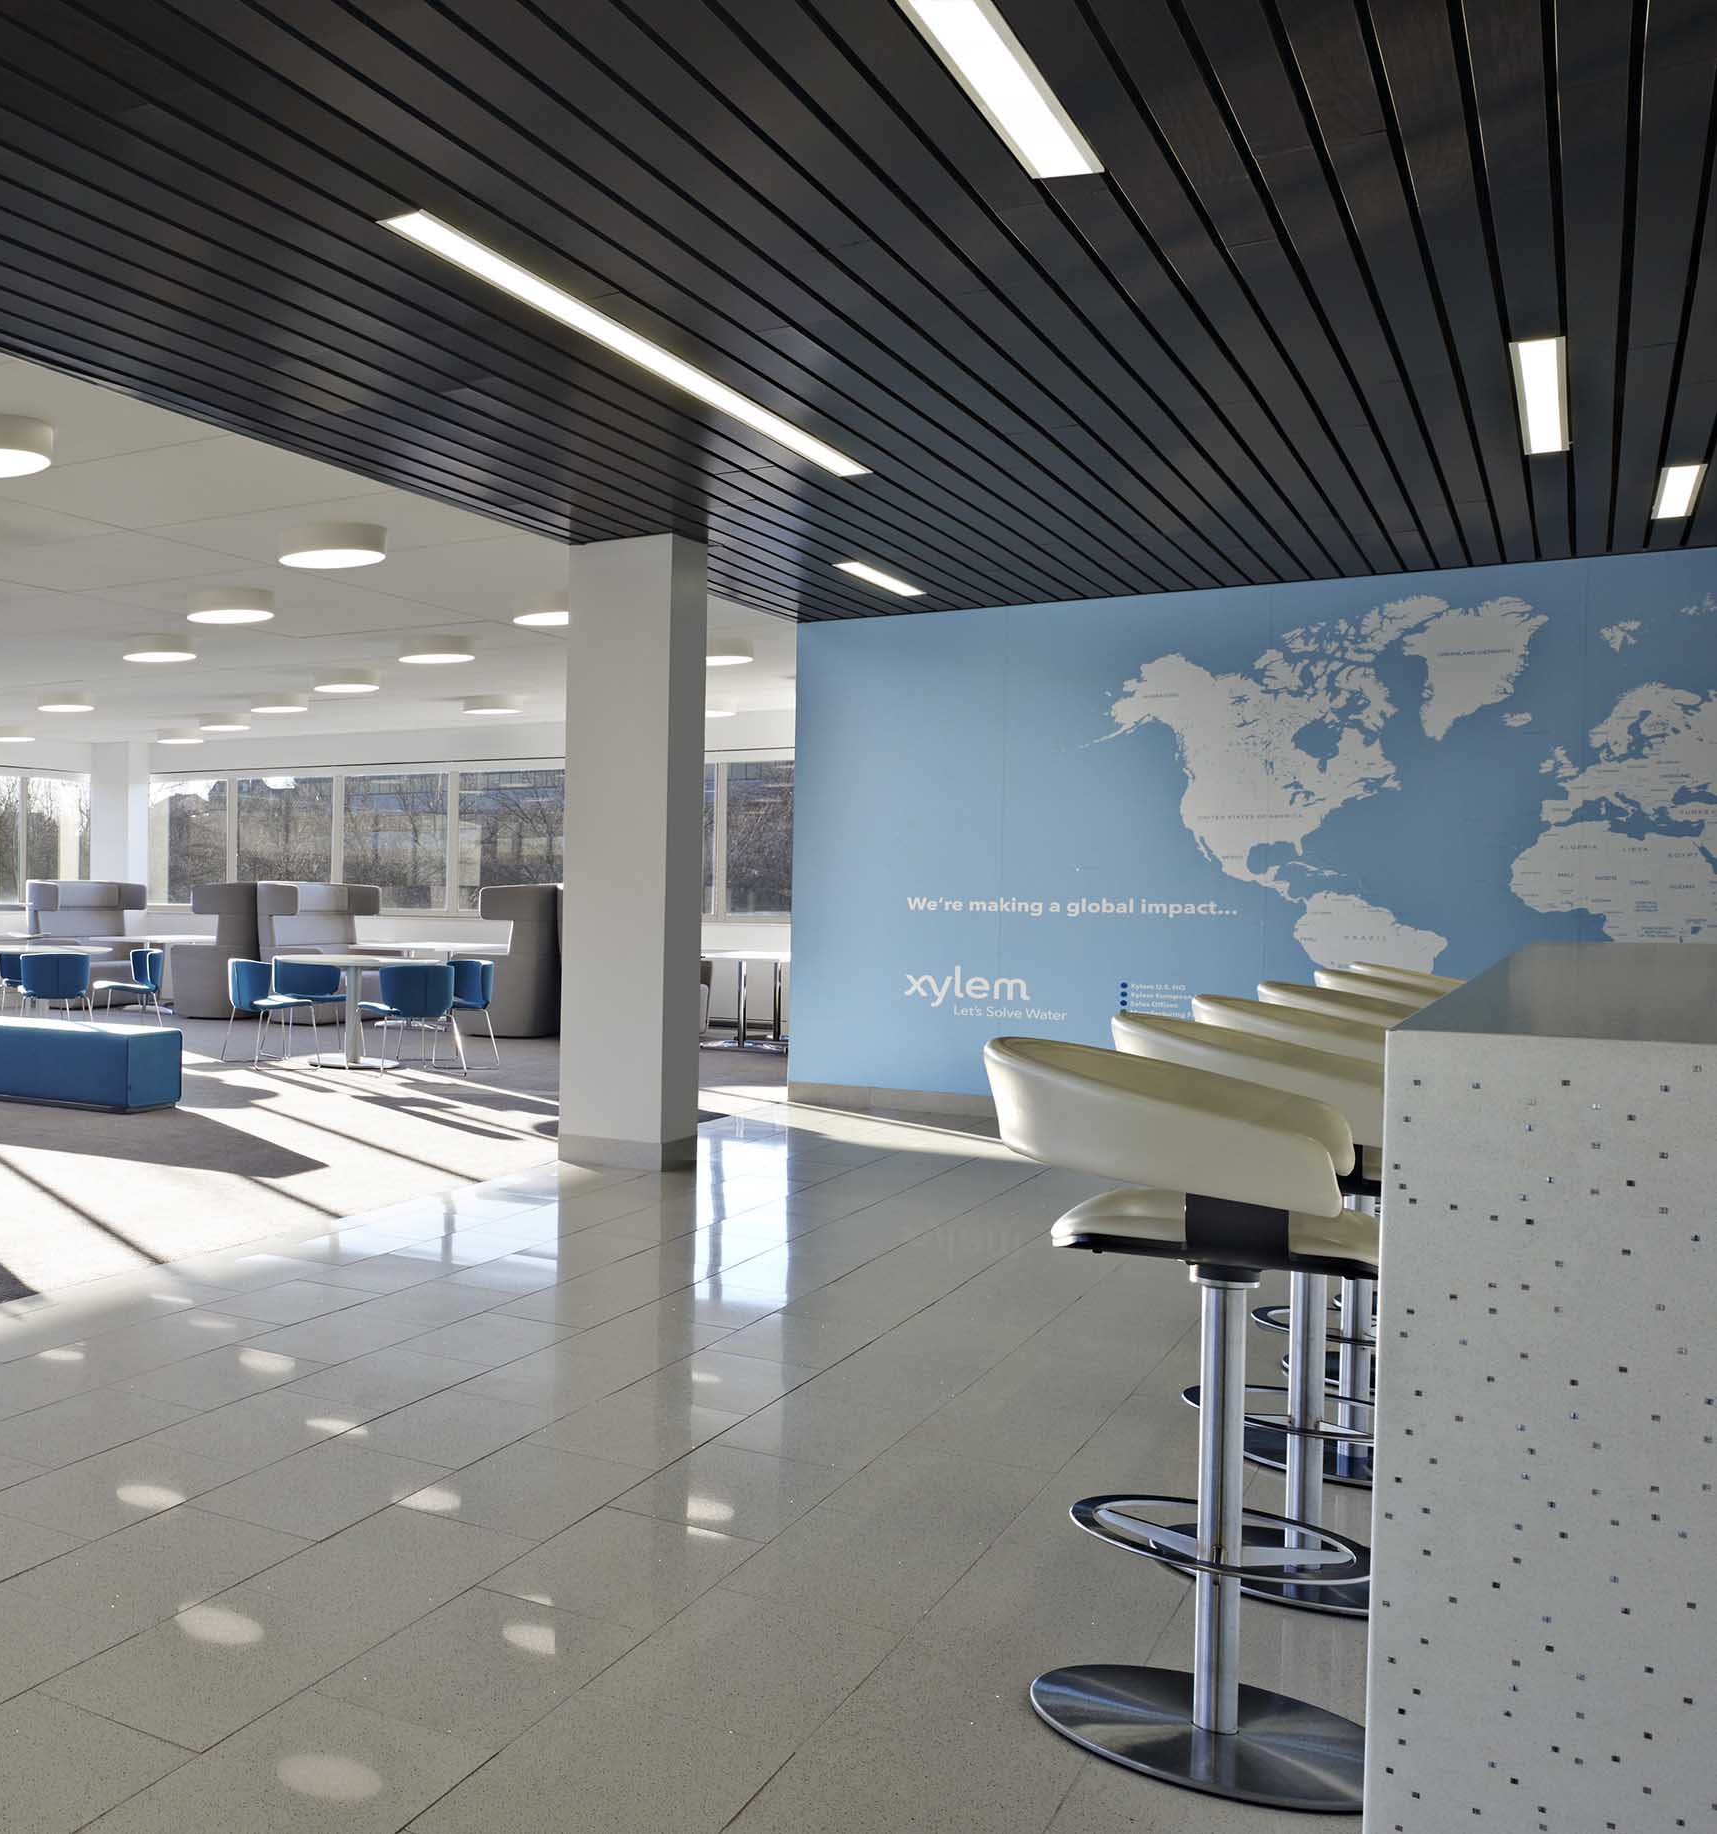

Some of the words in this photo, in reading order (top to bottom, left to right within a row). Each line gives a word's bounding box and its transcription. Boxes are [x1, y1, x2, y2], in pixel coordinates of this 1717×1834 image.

[906, 896, 964, 912] We're
[969, 896, 1043, 917] making
[1048, 901, 1061, 913] a
[1066, 898, 1134, 917] global
[1140, 899, 1238, 919] impact...
[904, 965, 1031, 1008] xylem
[954, 1005, 983, 1017] Let's
[986, 1006, 1023, 1019] Solve
[1025, 1008, 1068, 1021] Water
